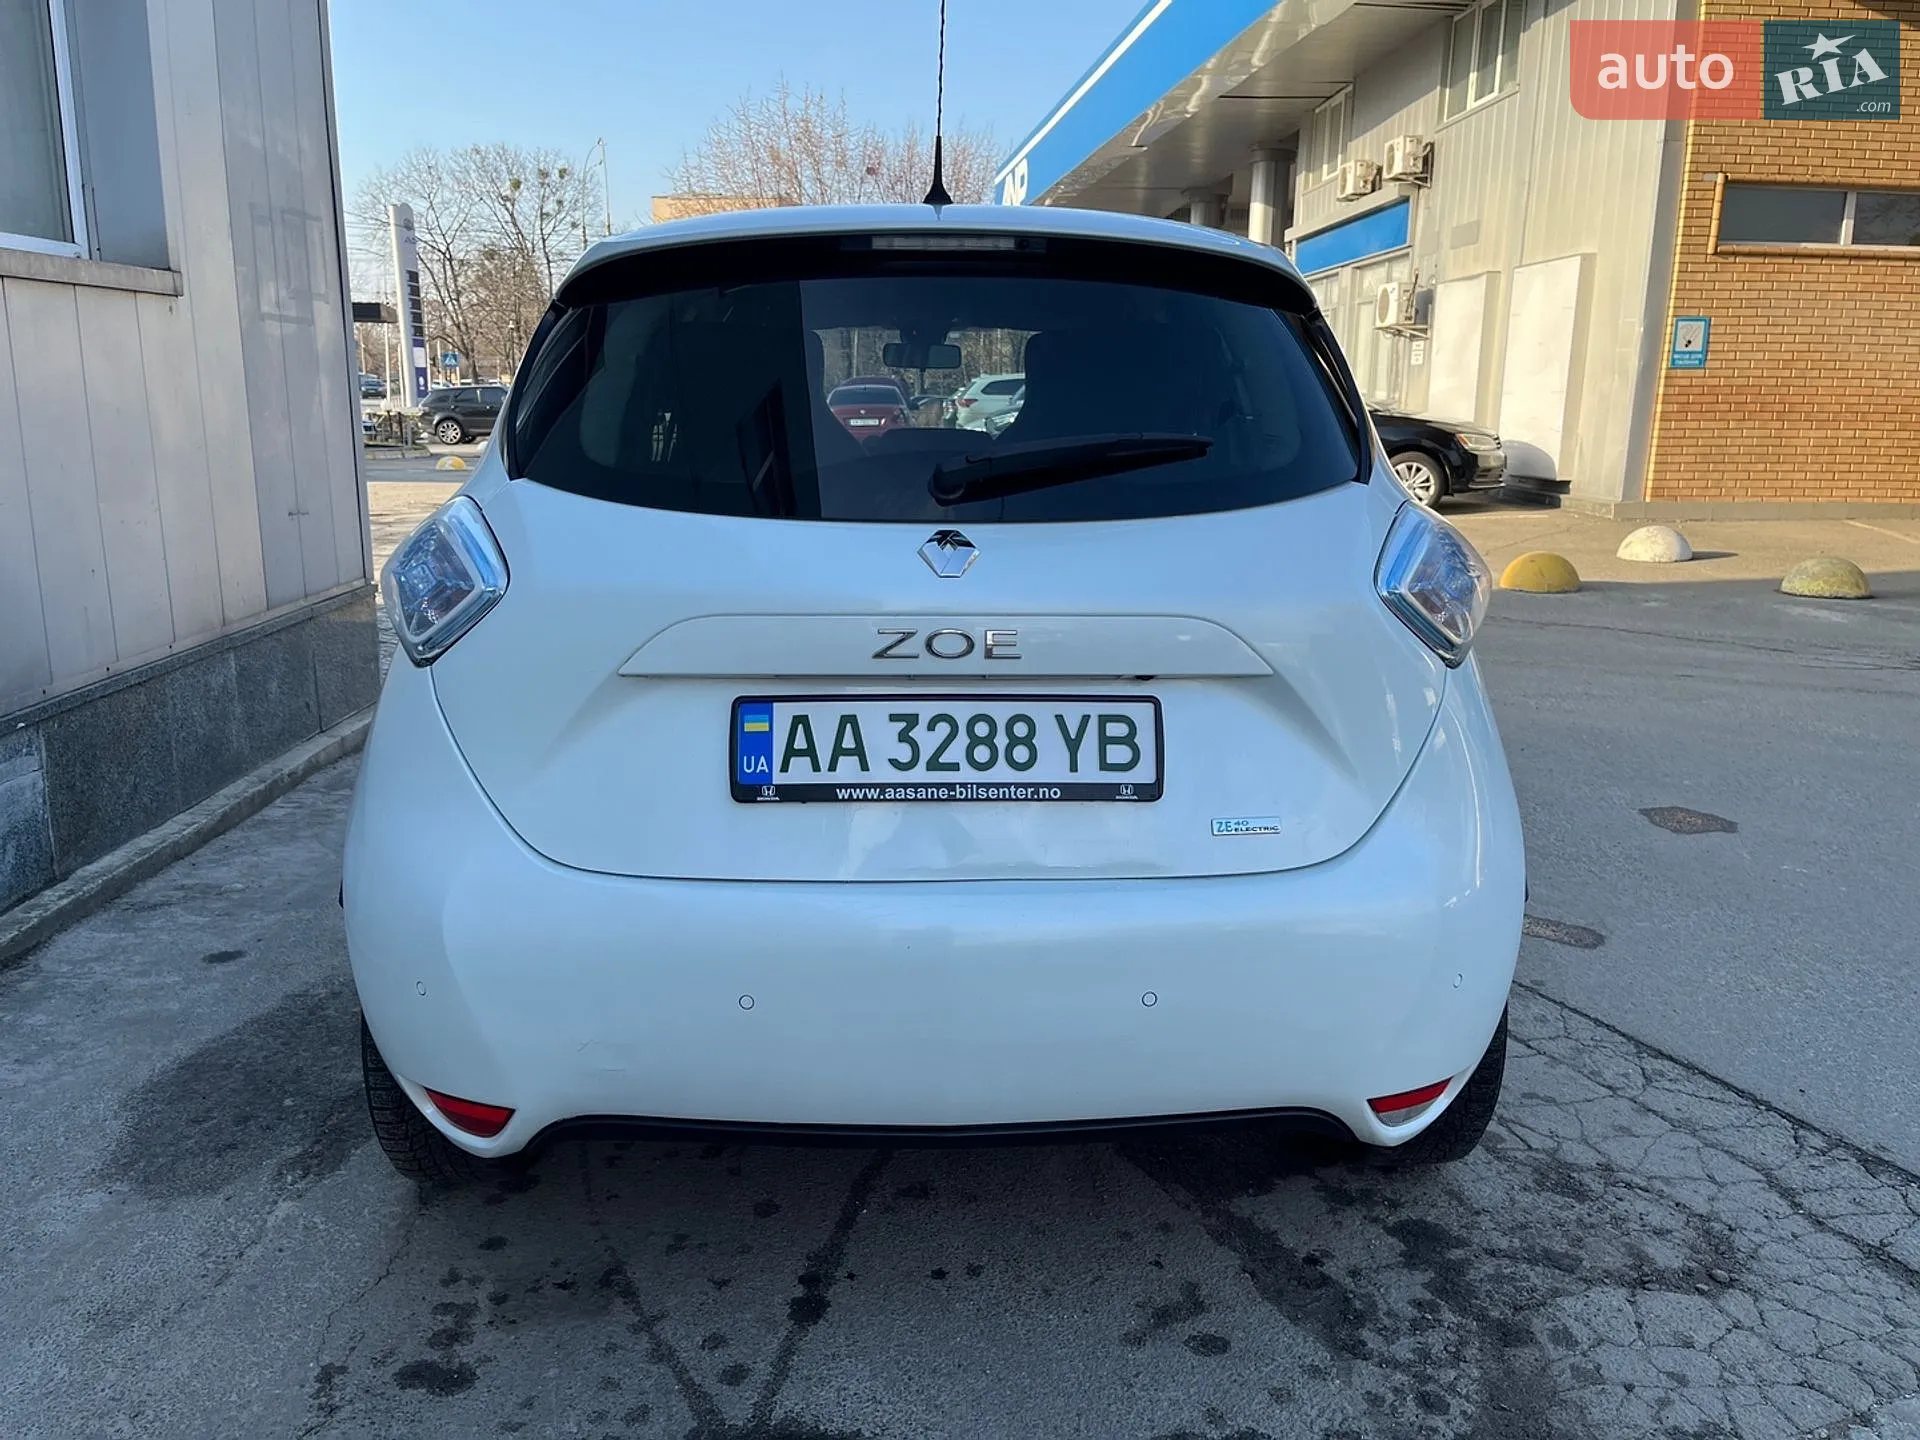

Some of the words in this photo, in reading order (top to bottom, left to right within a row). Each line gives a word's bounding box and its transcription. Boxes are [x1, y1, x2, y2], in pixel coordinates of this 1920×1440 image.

[872, 628, 1022, 659] ZOE
[778, 714, 870, 773] AA
[888, 713, 1038, 772] 3288
[1055, 713, 1141, 773] YB
[743, 755, 768, 773] UA
[836, 785, 1061, 799] www.aasane-bilsenter.no
[1215, 821, 1233, 832] ZE
